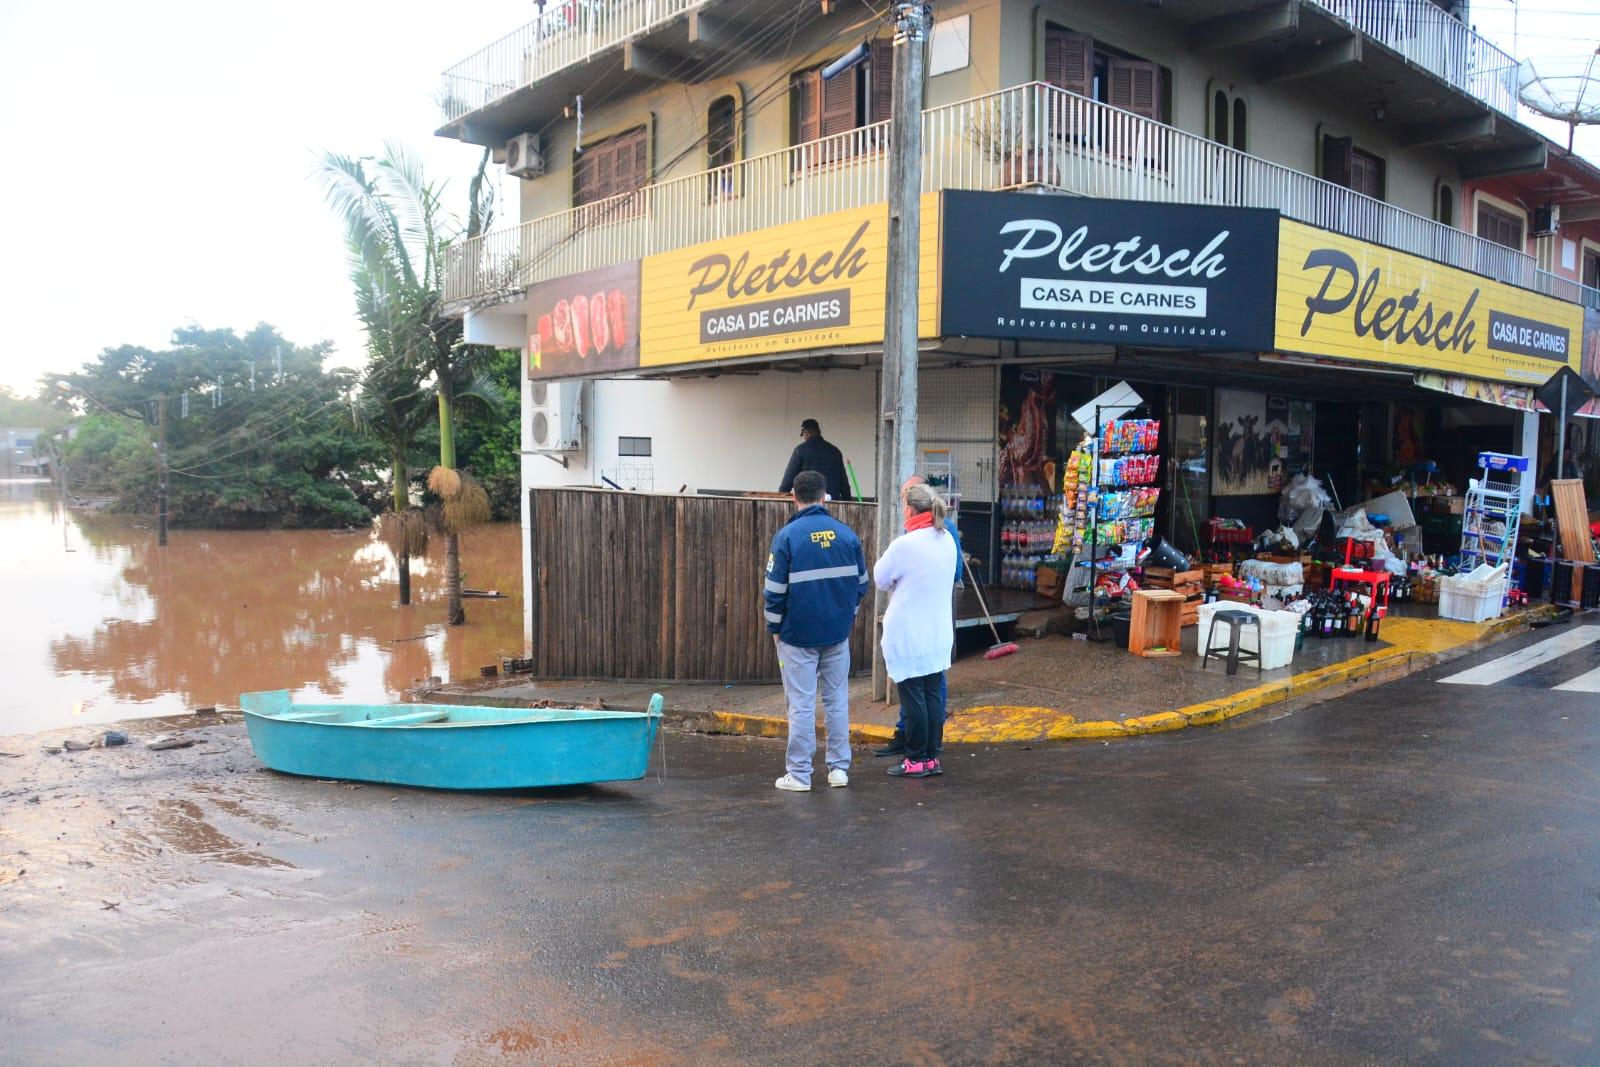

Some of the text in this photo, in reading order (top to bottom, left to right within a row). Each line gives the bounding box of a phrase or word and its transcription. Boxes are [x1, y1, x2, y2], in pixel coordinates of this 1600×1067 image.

[687, 220, 870, 310] Pletsch
[999, 218, 1230, 279] Pletsch
[1032, 287, 1196, 309] CASA DE CARNES
[1300, 248, 1480, 354] Pletsch
[707, 299, 841, 335] CASA DE CARNES
[997, 317, 1227, 337] Referência em Qualidade
[1492, 321, 1566, 354] CASA DE CARNES
